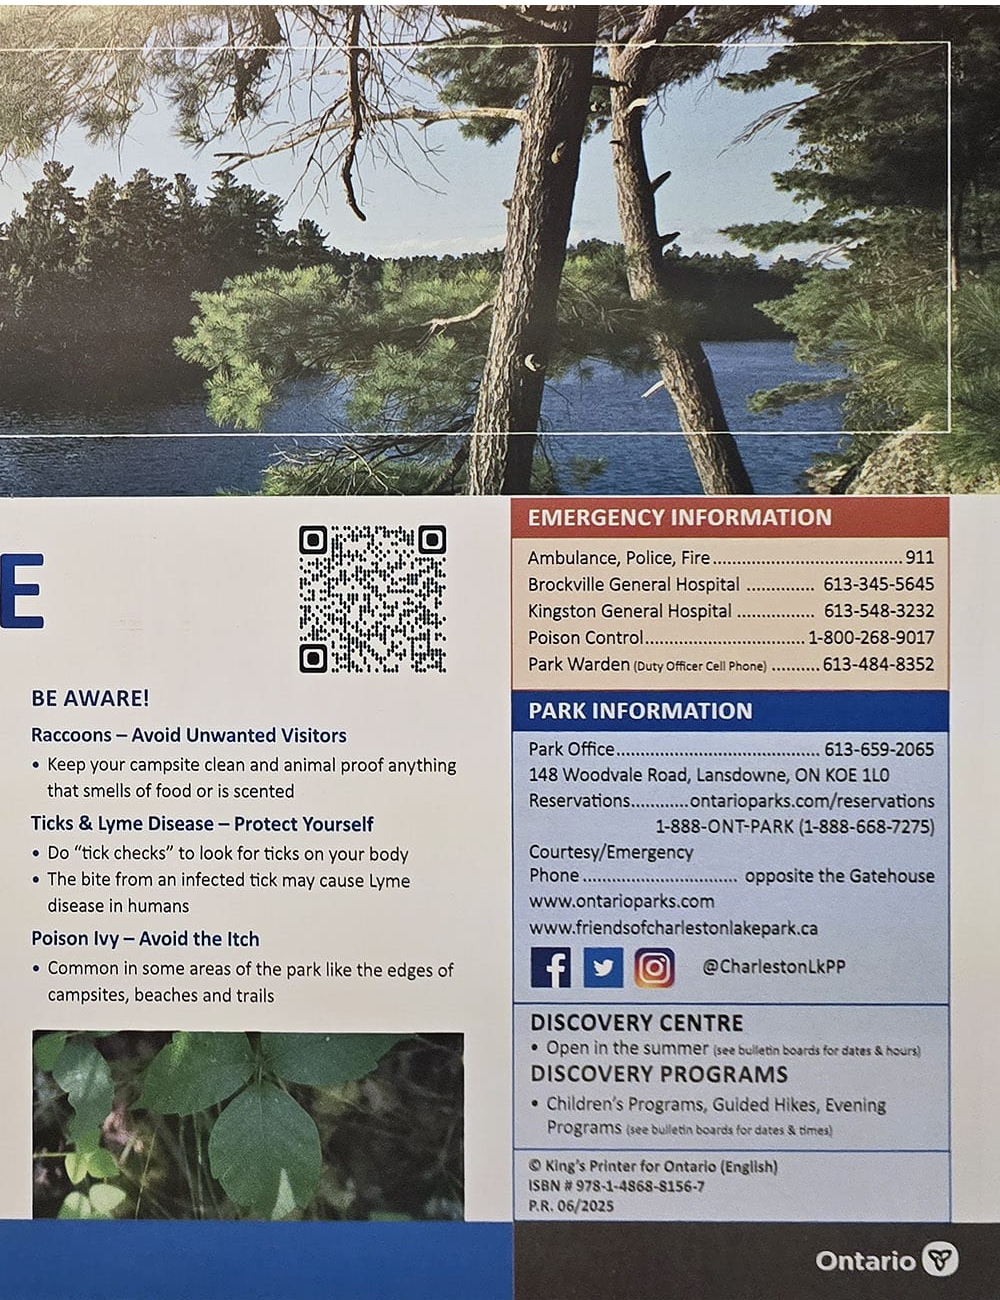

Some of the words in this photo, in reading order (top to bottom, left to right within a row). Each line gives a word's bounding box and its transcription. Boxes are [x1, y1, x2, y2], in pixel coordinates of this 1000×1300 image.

[529, 509, 665, 526] EMERGENCY
[672, 508, 831, 526] INFORMATION
[528, 550, 620, 567] Ambulance,
[627, 550, 676, 567] Police,
[906, 550, 934, 565] 911
[528, 576, 604, 592] Brockville
[609, 576, 670, 592] General
[677, 576, 739, 595] Hospital
[824, 577, 934, 591] 613-345-5645
[33, 690, 57, 706] BE
[64, 689, 148, 707] AWARE!
[529, 702, 586, 719] PARK
[593, 702, 752, 720] INFORMATION
[32, 727, 112, 742] Raccoons
[132, 727, 180, 742] Avoid
[187, 727, 276, 743] Unwanted
[281, 727, 347, 743] Visitors
[529, 843, 694, 862] Courtesy/Emergency
[529, 893, 714, 911] www.ontarioparks.com
[529, 919, 818, 938] www.friendsofcharlestonlakepark.ca
[703, 958, 846, 975] @CharlestonLkPP
[48, 987, 129, 1005] campsites,
[135, 987, 198, 1002] beaches
[203, 987, 231, 1002] and
[236, 988, 274, 1003] trails
[532, 1013, 653, 1032] DISCOVERY
[660, 1014, 743, 1032] CENTRE
[590, 1160, 637, 1172] Printer
[640, 1159, 660, 1173] for
[664, 1160, 716, 1173] Ontario
[721, 1160, 778, 1175] (English)
[529, 1200, 553, 1212] P.R.
[557, 1199, 614, 1214] 06/2025
[816, 1250, 916, 1271] Ontario
